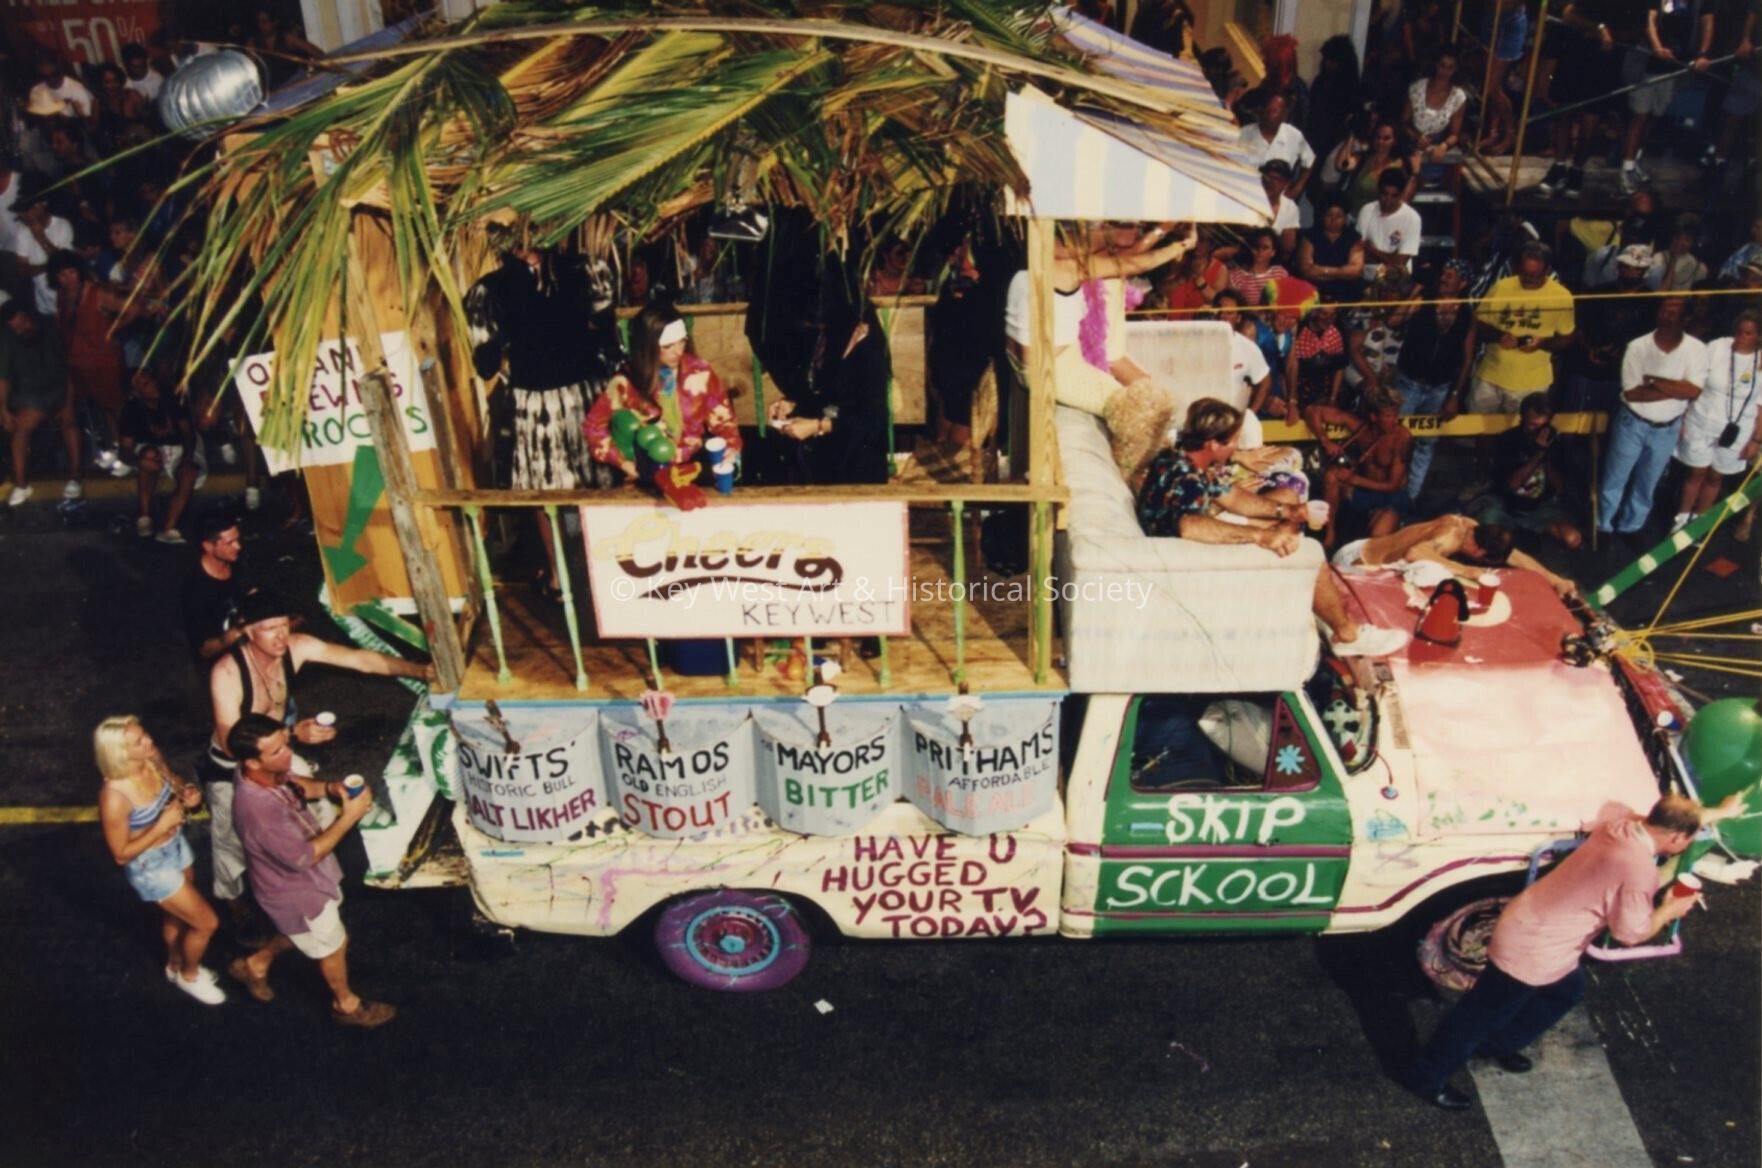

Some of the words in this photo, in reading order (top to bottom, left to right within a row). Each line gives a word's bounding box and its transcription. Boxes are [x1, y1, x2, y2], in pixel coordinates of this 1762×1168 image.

[300, 405, 428, 449] ROCS
[1408, 417, 1441, 430] WEST
[742, 603, 799, 627] KEY
[808, 601, 896, 626] WEST
[614, 741, 731, 781] RAMOS
[777, 735, 887, 775] MAYORS
[468, 771, 537, 798] HISTORIC
[543, 776, 576, 795] BULL
[622, 773, 650, 793] OLD
[656, 775, 727, 799] ENGLISH
[785, 768, 890, 808] BITTER
[949, 760, 1051, 793] AFFORDABLE
[511, 787, 597, 831] LIKHER
[623, 791, 732, 832] STOUT
[1165, 793, 1307, 845] SKIP
[854, 834, 958, 862] HAVE
[988, 832, 1018, 864] U
[821, 861, 988, 893] HUGGED
[1106, 861, 1334, 910] SCKOOL
[852, 889, 963, 926] YOUR
[882, 907, 1048, 938] TODAY?
